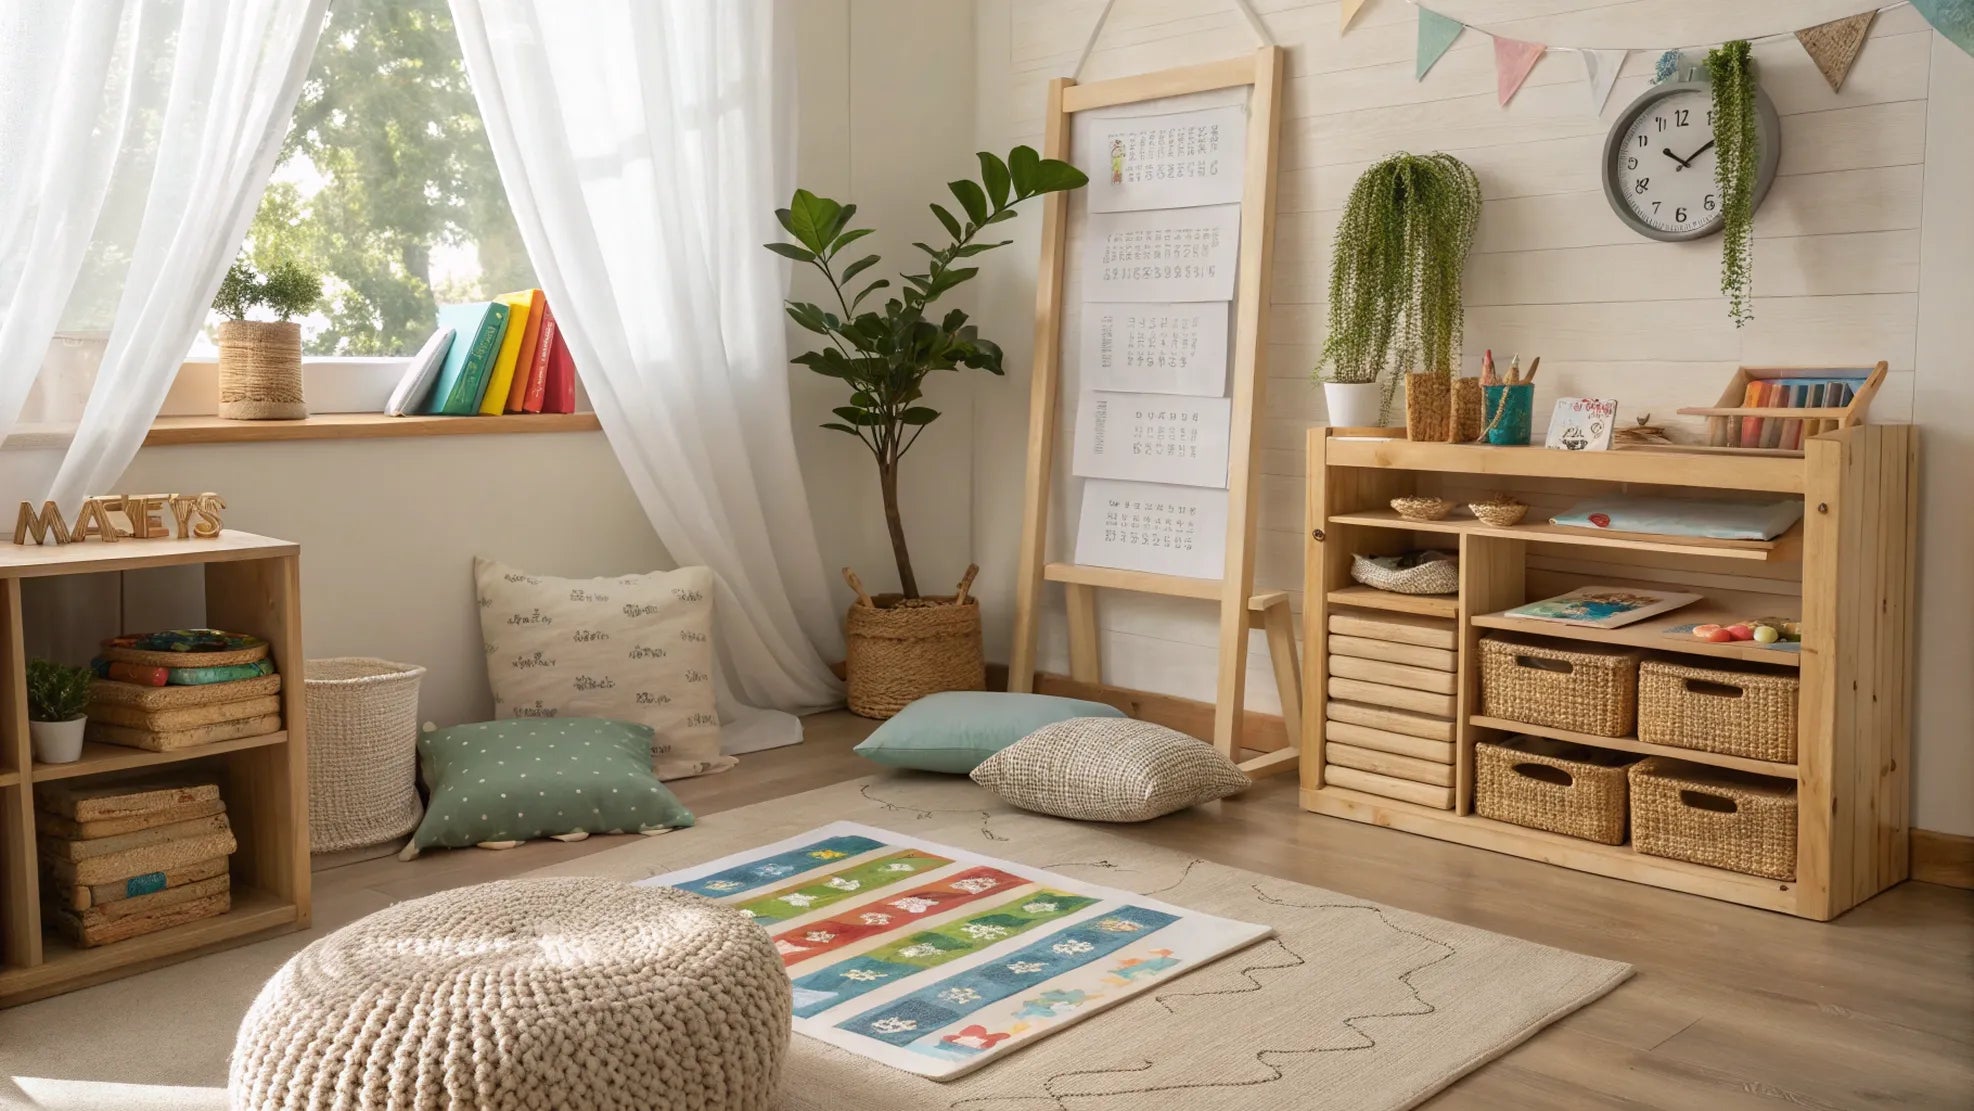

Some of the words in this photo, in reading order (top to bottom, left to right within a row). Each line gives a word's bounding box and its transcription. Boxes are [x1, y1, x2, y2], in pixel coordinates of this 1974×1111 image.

[1674, 109, 1689, 127] 12
[1652, 201, 1662, 215] 7
[1675, 207, 1687, 223] 6
